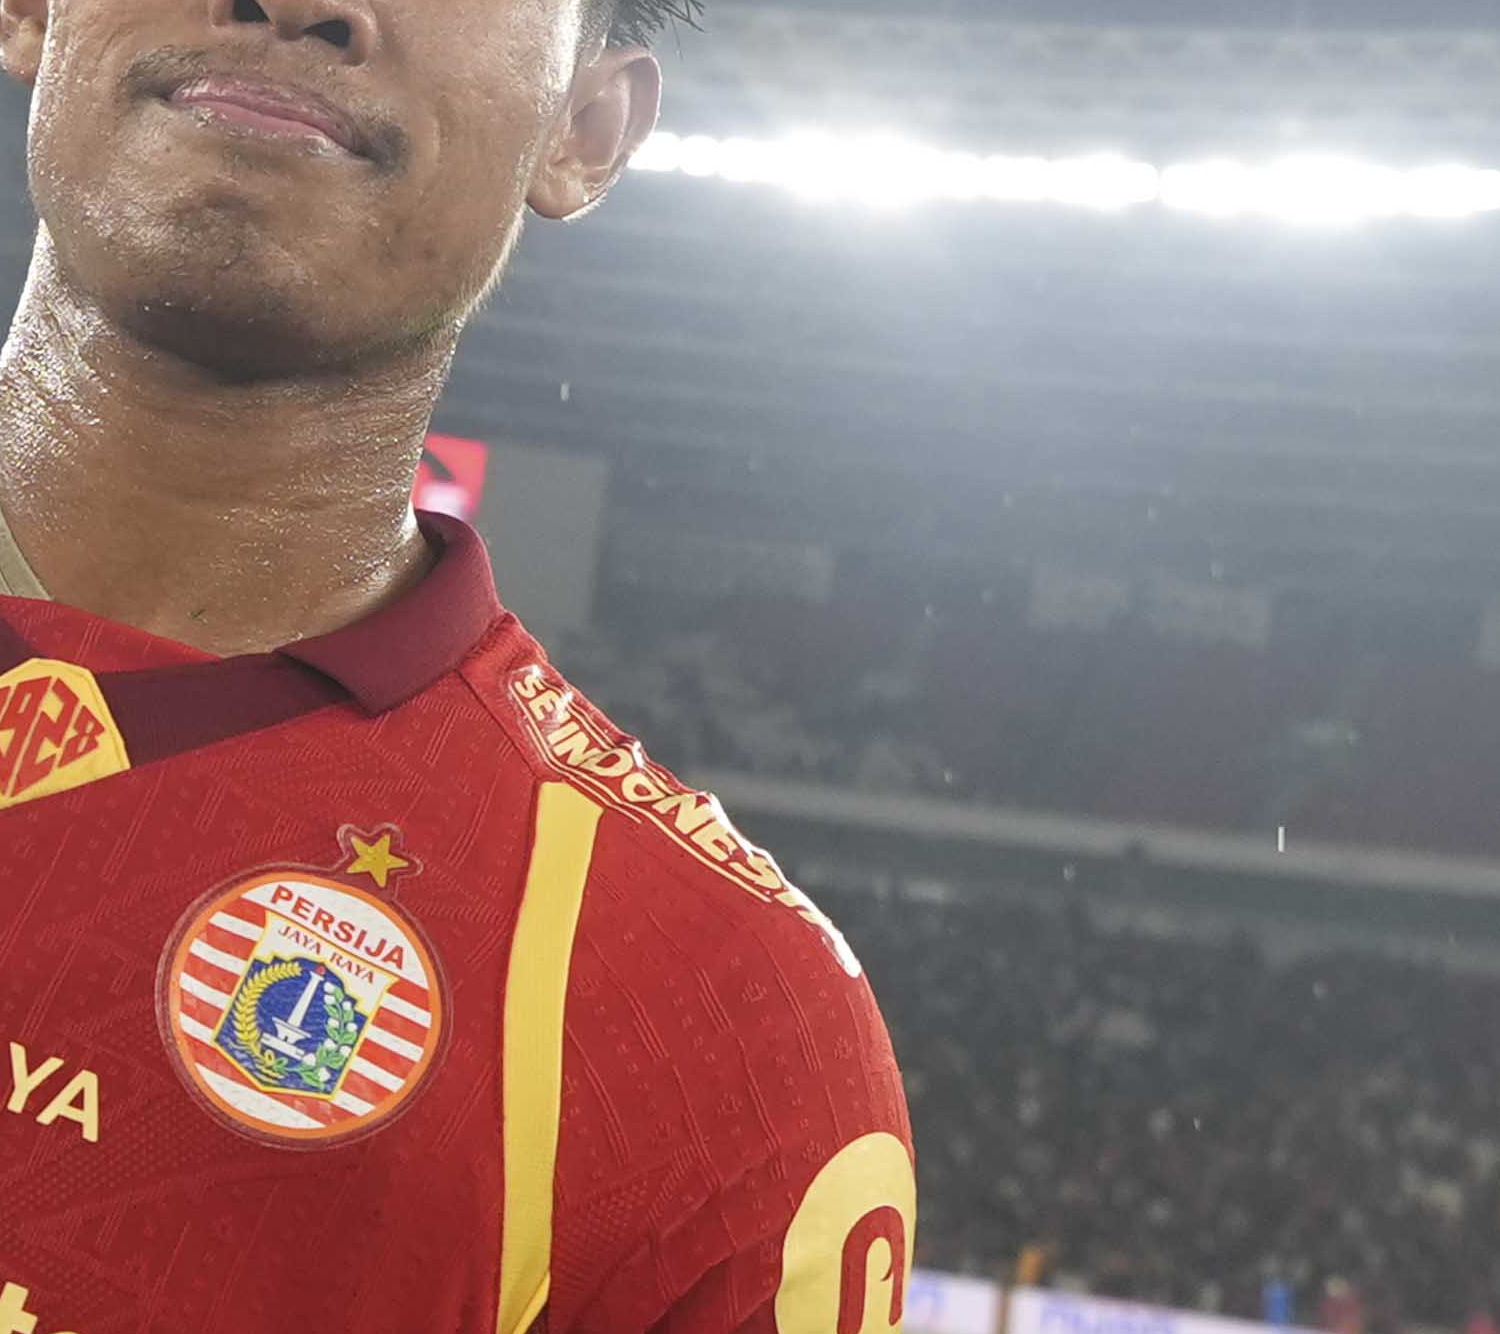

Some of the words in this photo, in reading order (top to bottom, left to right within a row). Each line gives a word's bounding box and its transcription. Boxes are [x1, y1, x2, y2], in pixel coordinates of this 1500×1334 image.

[270, 885, 405, 971] PERSIJA
[277, 924, 322, 956] JAYA
[329, 953, 375, 985] RAYA
